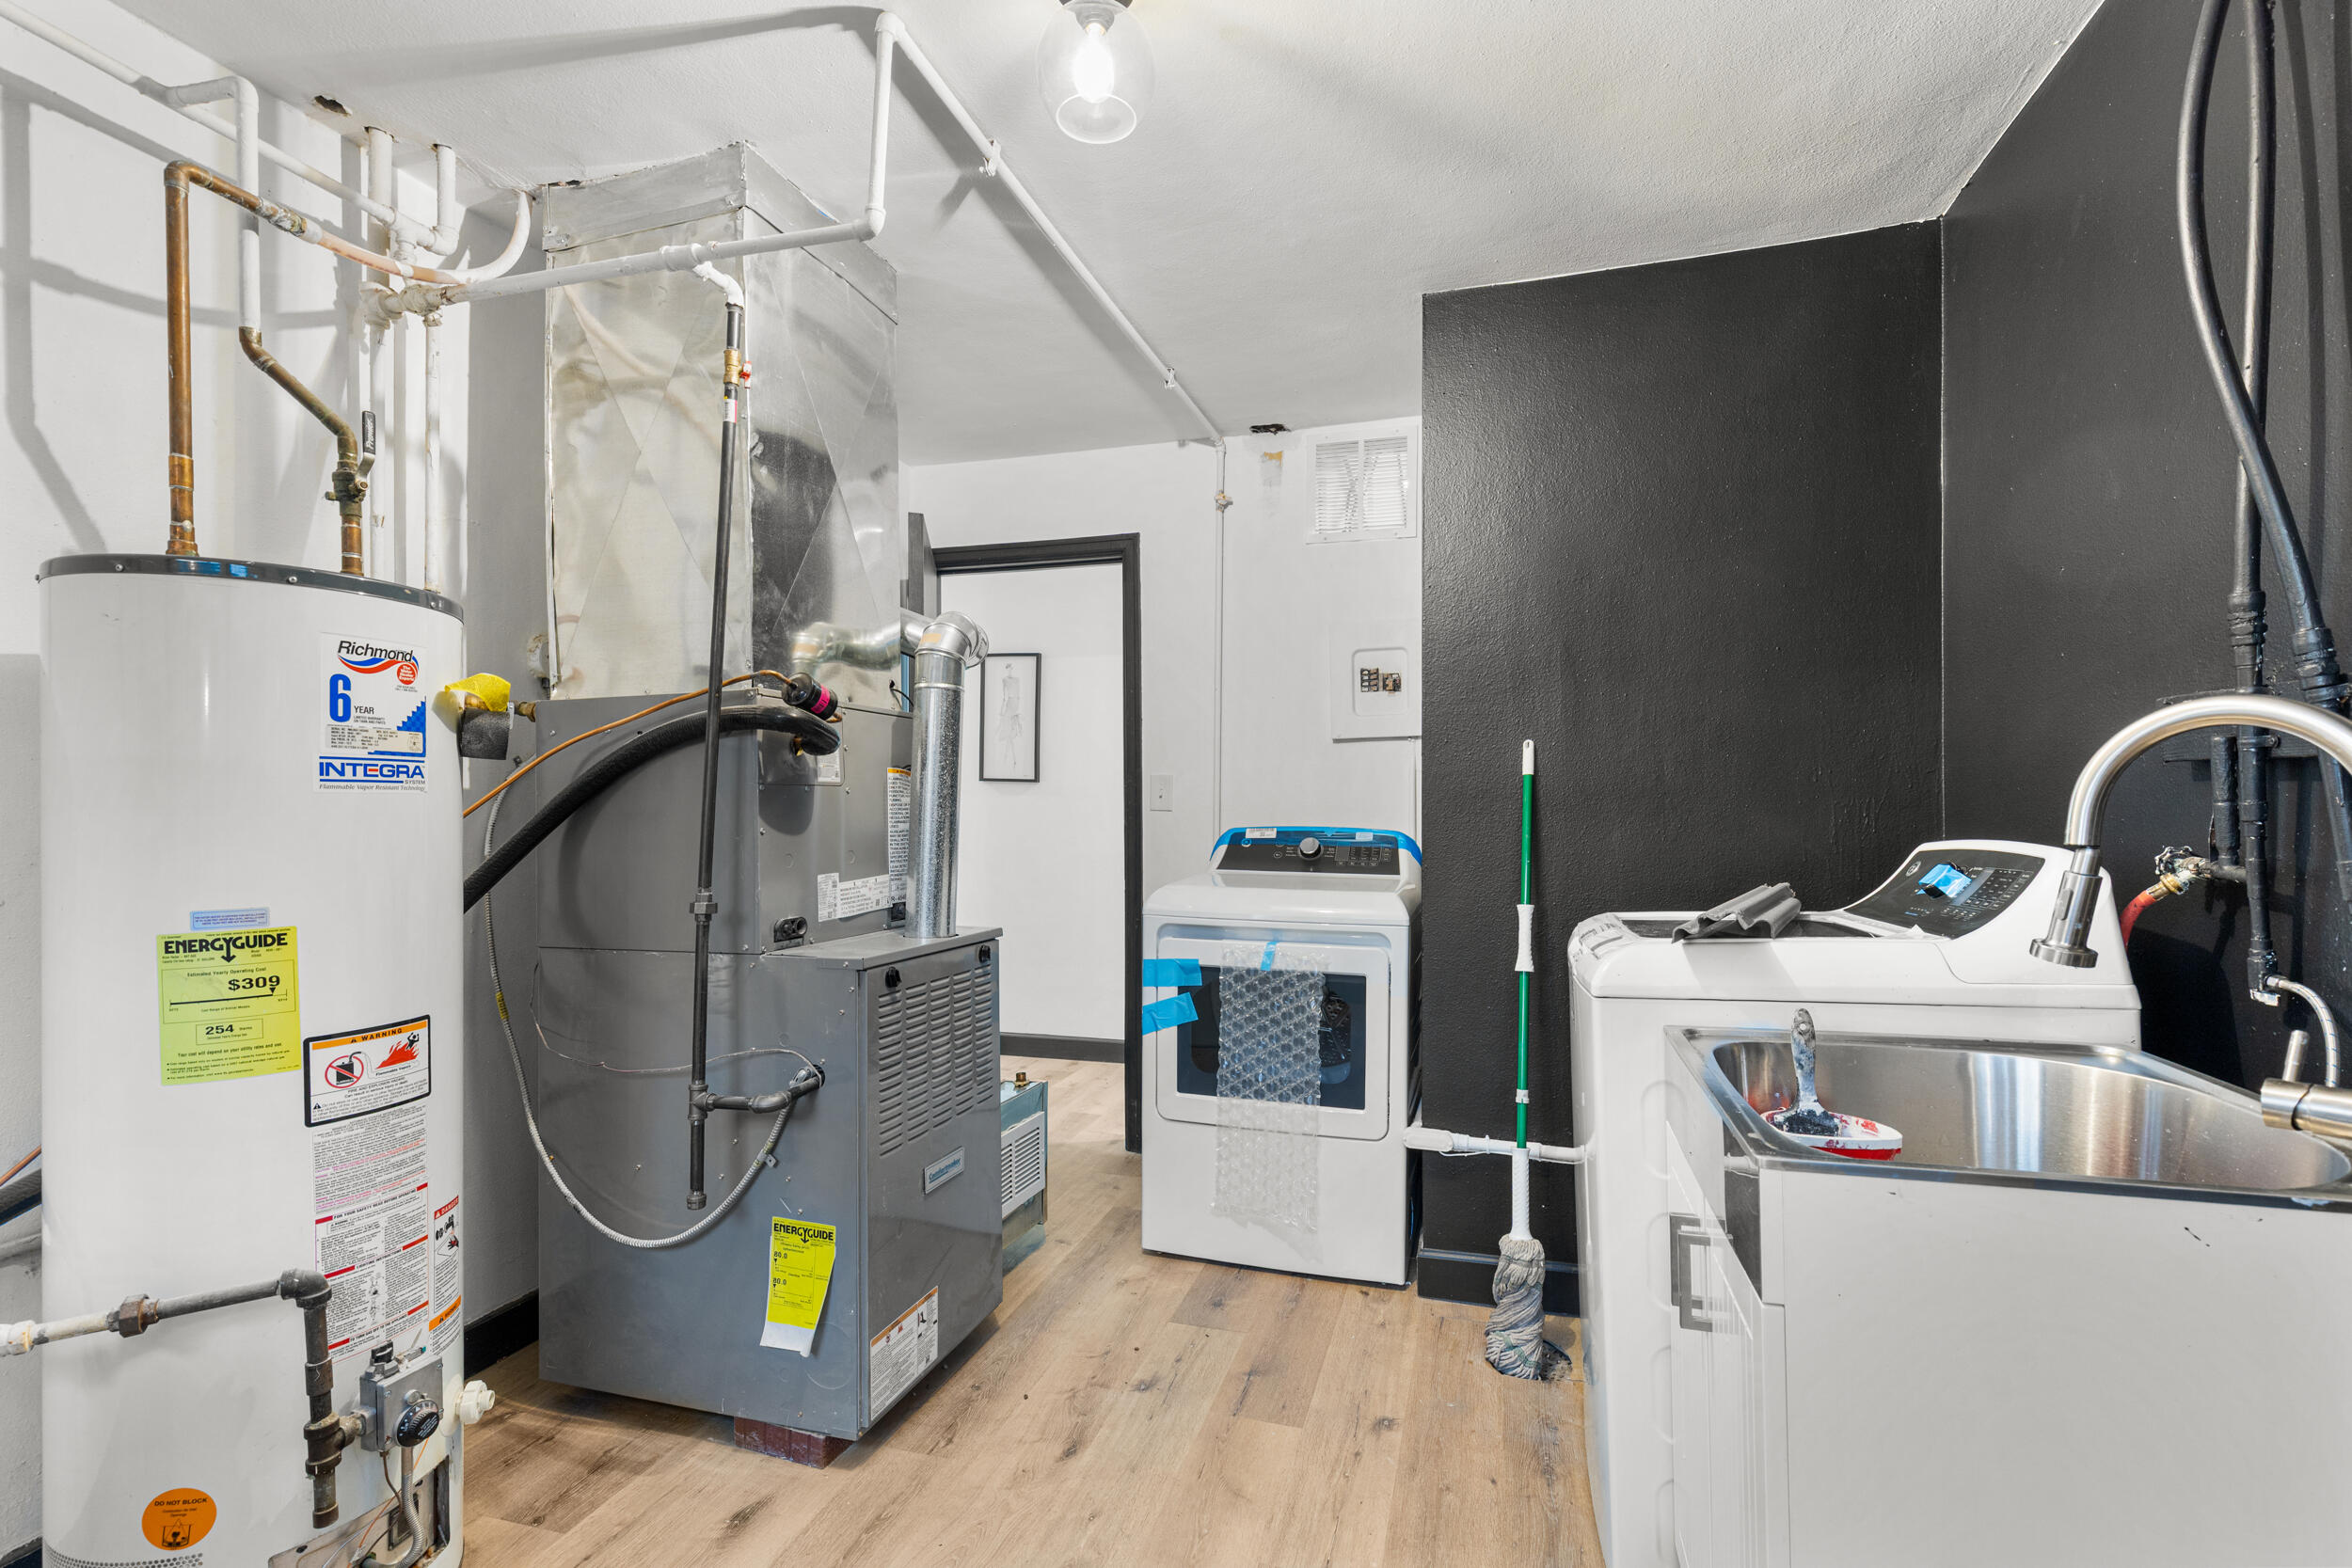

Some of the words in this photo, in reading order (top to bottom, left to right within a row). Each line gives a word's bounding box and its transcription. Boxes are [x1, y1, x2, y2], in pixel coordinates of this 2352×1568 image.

[338, 641, 413, 661] Richmond
[329, 673, 351, 722] 6
[319, 762, 424, 779] INTEGRA
[165, 933, 288, 958] ENERGYGUIDE
[228, 975, 280, 991] $309
[205, 1024, 233, 1035] 254
[361, 1027, 403, 1041] WARNING
[773, 1223, 834, 1242] ENERGYGUIDE
